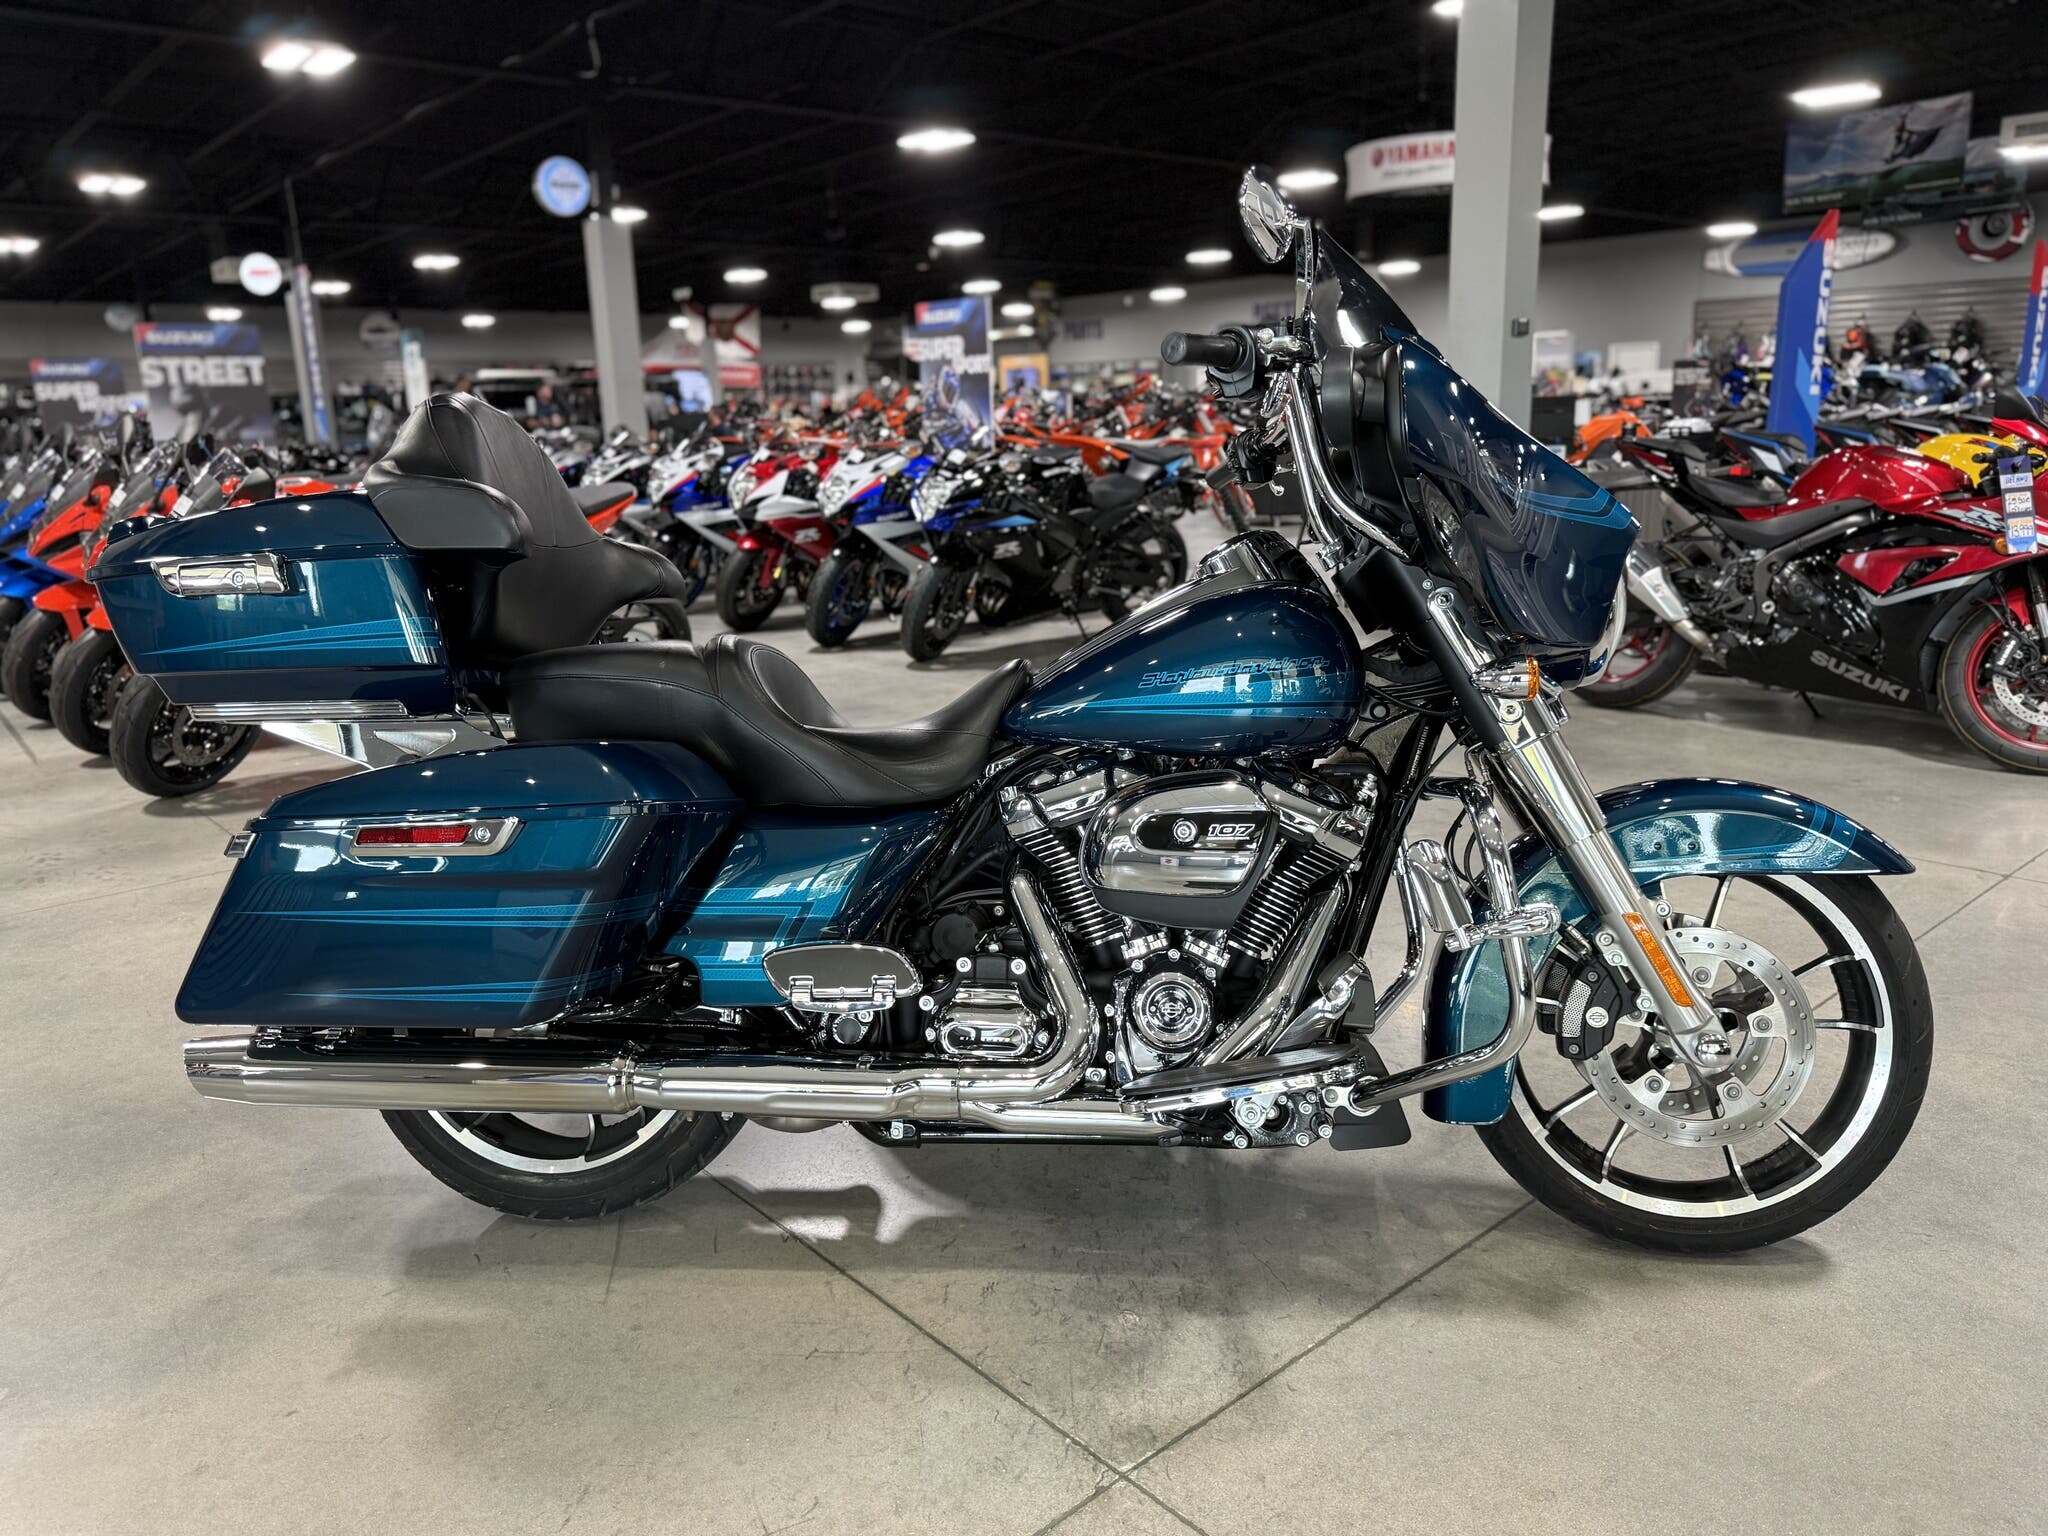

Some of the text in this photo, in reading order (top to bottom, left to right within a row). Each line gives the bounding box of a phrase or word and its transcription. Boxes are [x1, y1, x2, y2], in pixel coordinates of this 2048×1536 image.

[140, 356, 266, 386] STREET
[1810, 649, 1910, 702] SUZUKI
[1207, 823, 1255, 837] 107
